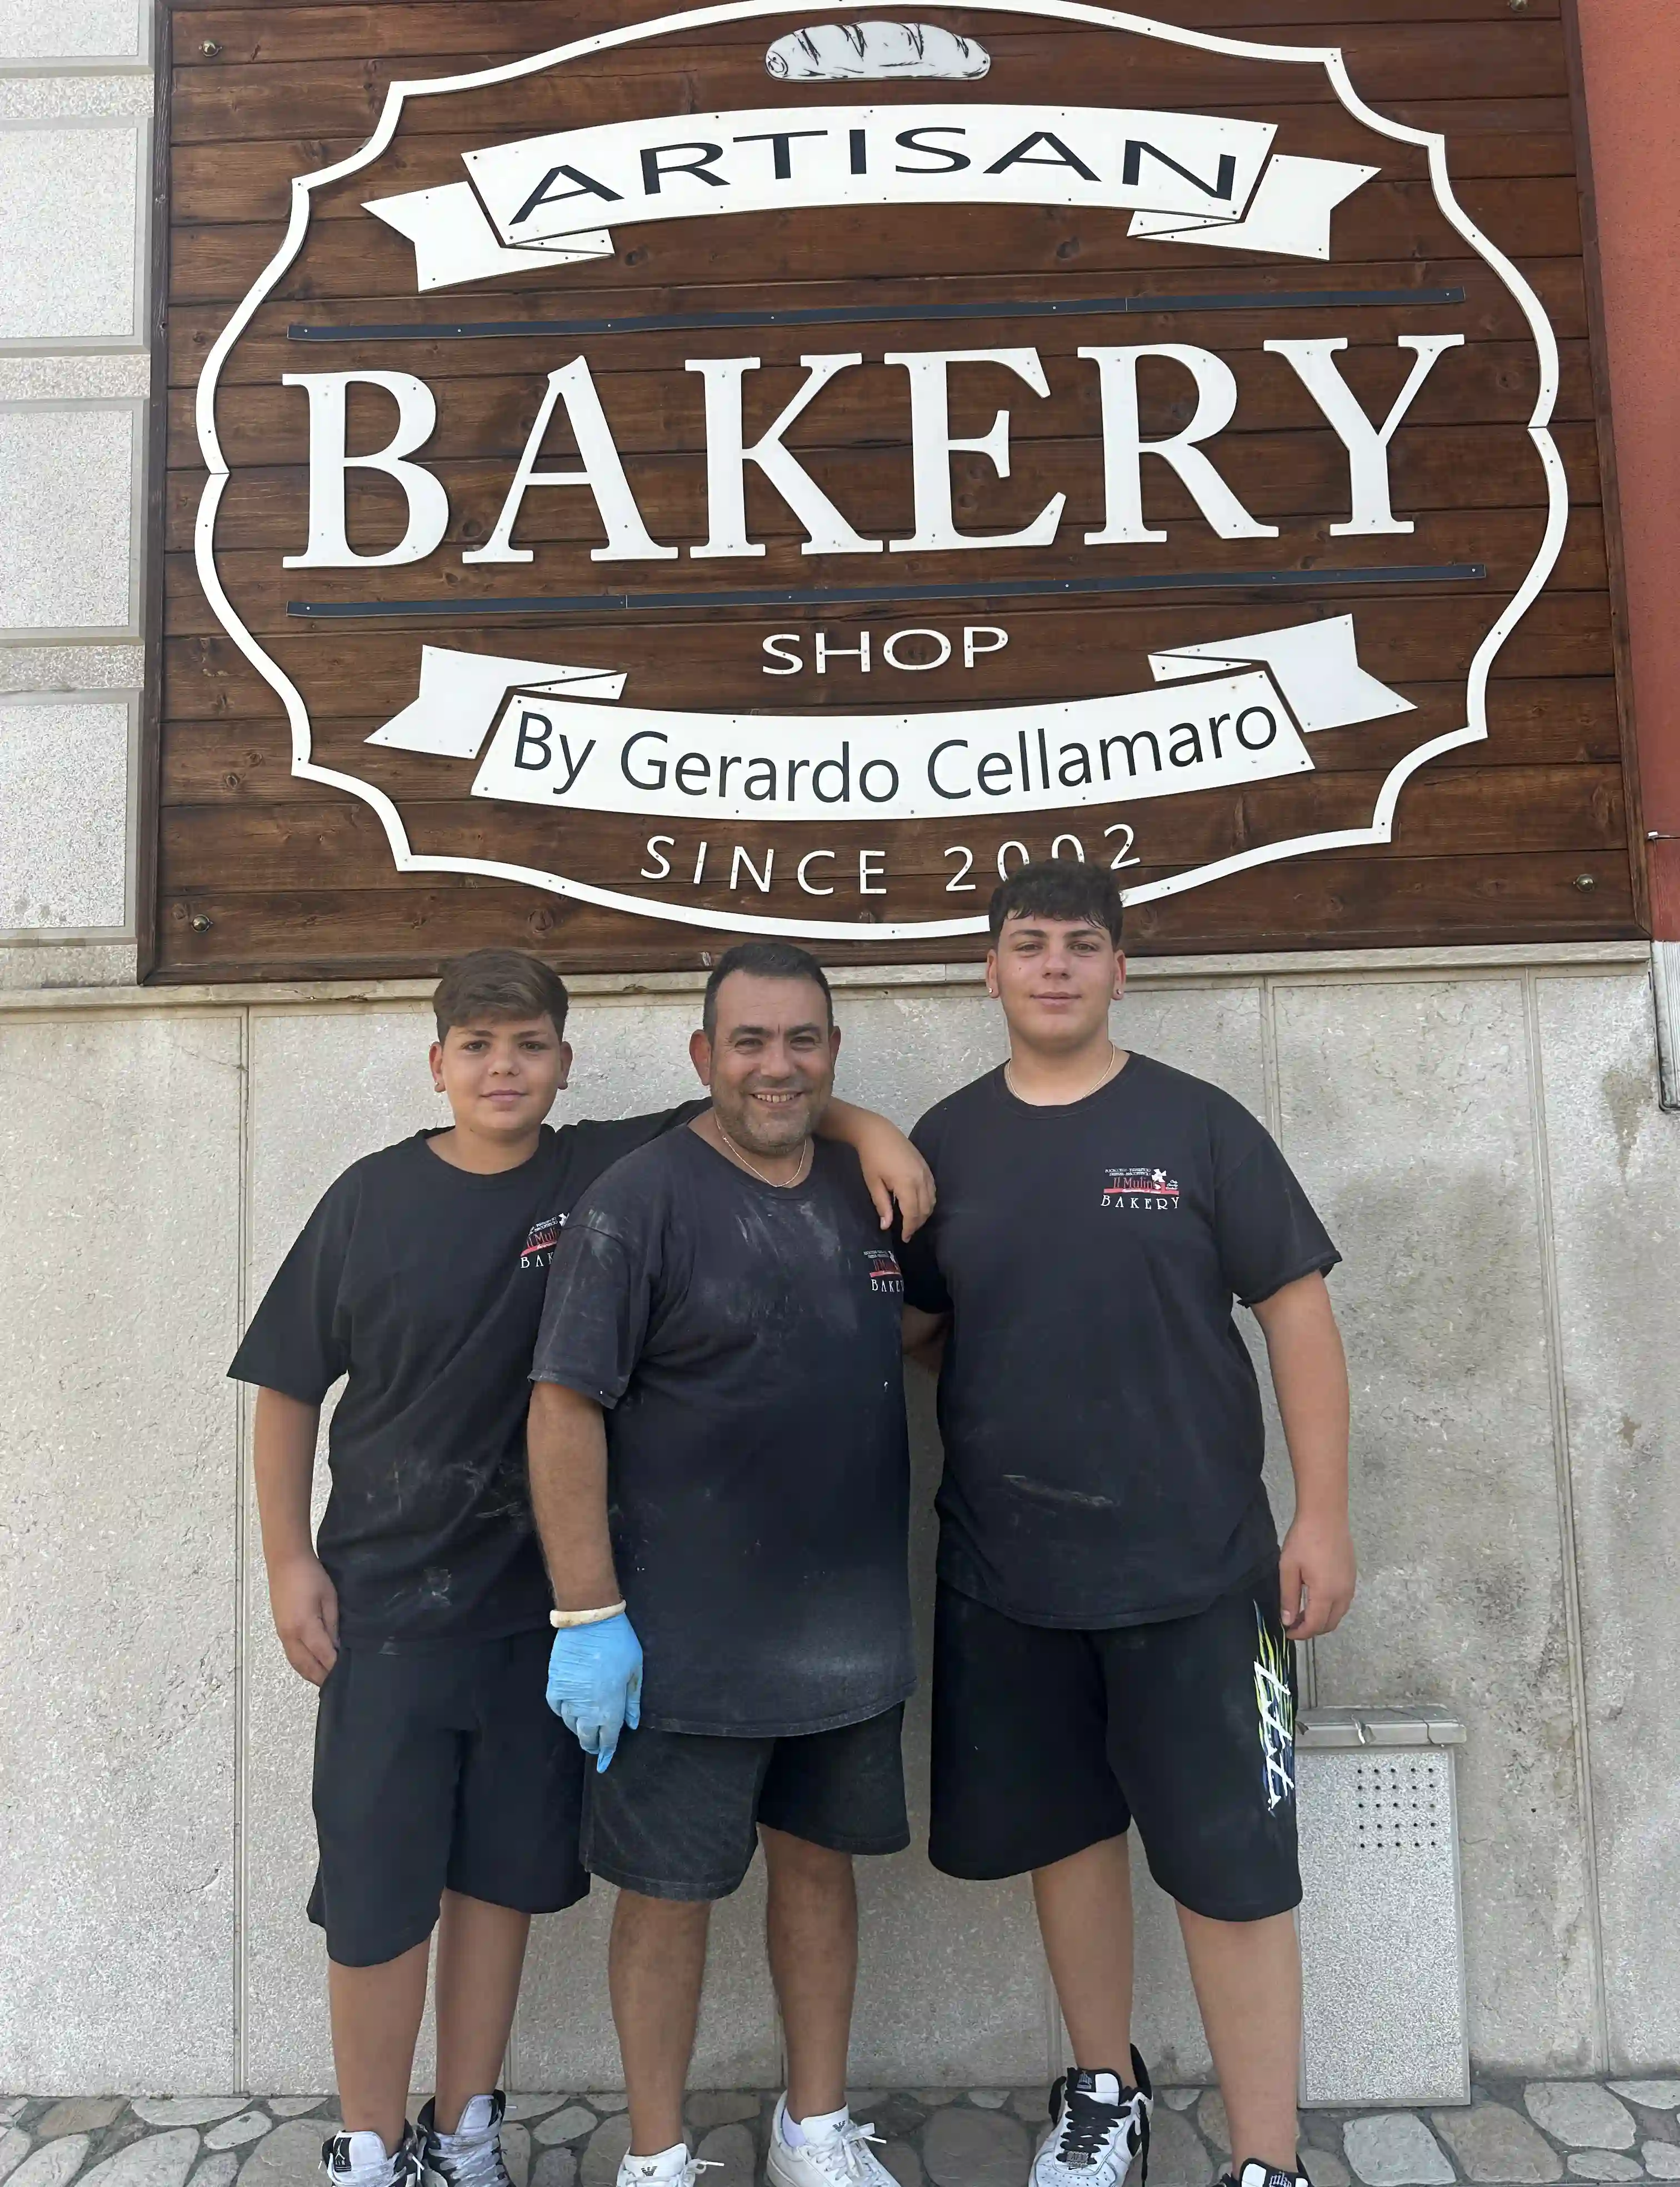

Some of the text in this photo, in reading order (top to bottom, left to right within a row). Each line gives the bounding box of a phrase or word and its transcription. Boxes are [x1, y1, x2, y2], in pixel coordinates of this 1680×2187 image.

[508, 127, 1236, 226] ARTISAN
[282, 334, 1465, 568] BAKERY
[762, 627, 1008, 675] SHOP
[514, 706, 1277, 803] By Gerardo Cellamaro
[641, 835, 888, 895] SINCE
[1101, 1194, 1179, 1210] BAKERY
[521, 1252, 554, 1269] BAK
[871, 1279, 904, 1292] BAKE
